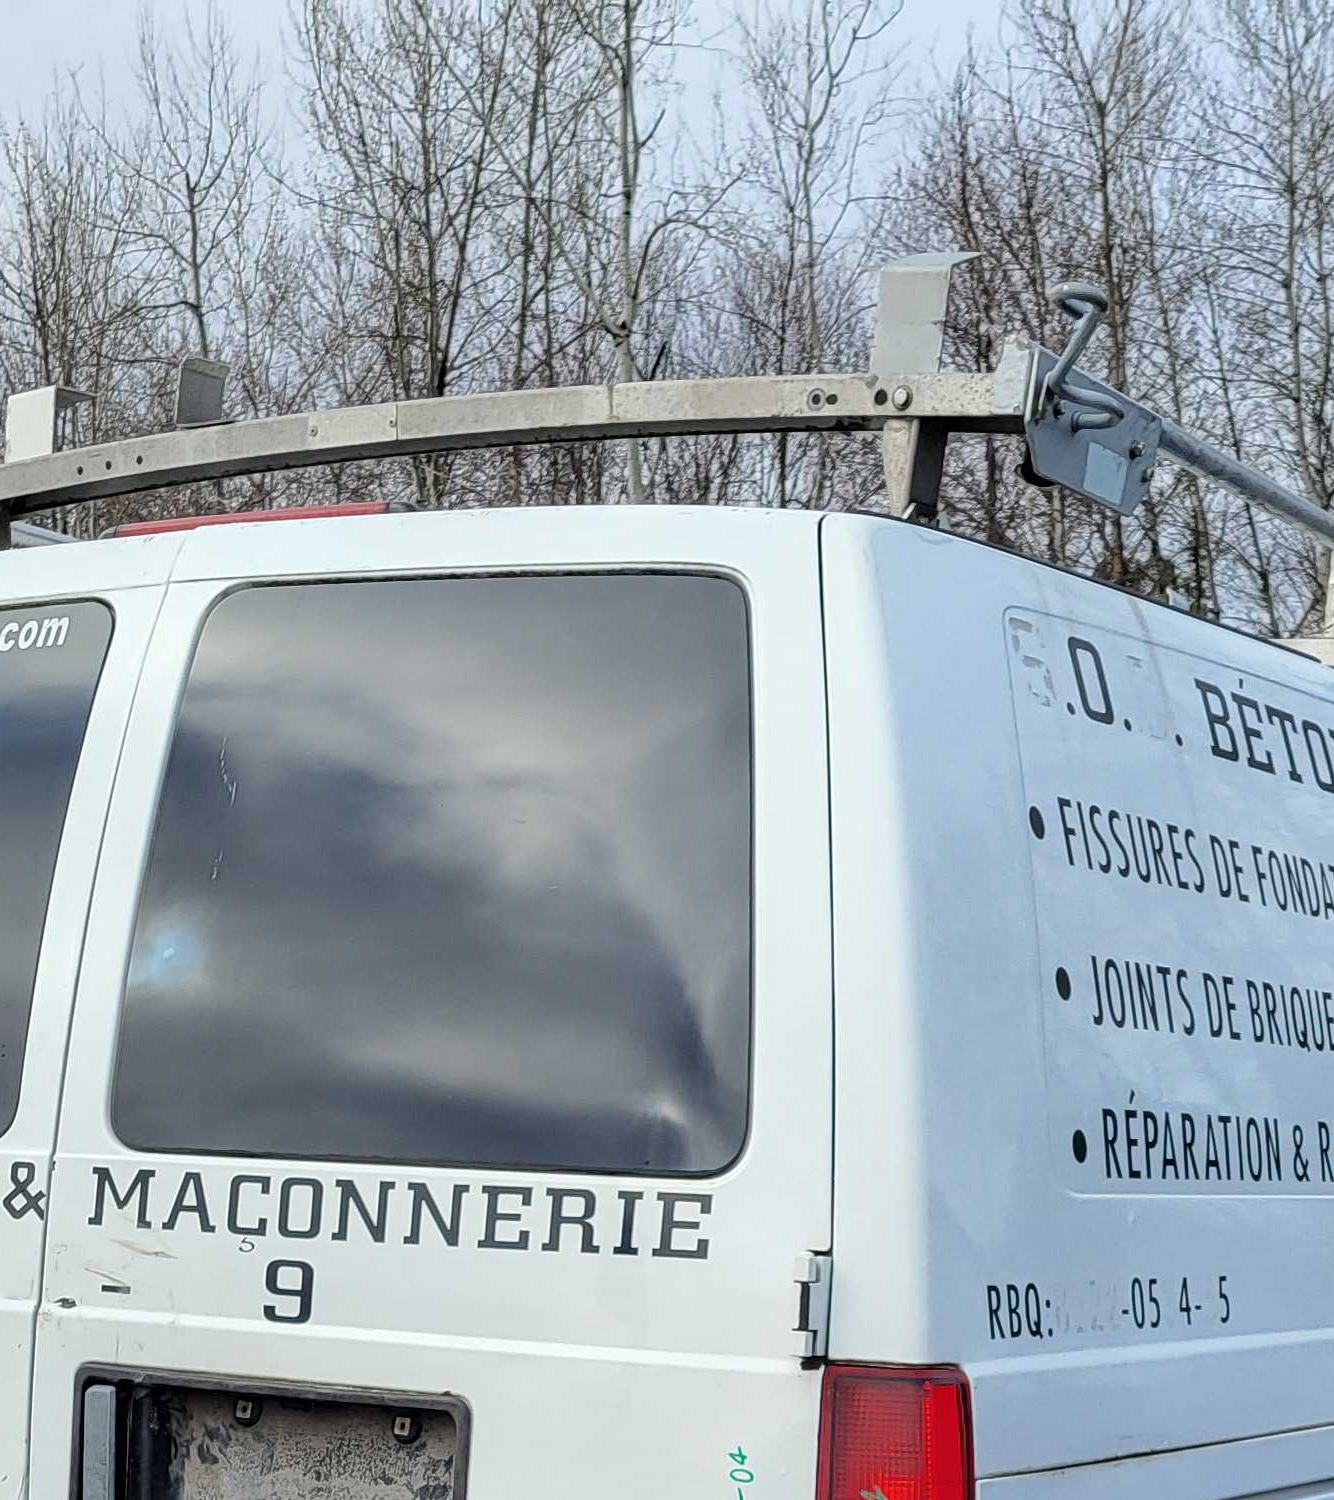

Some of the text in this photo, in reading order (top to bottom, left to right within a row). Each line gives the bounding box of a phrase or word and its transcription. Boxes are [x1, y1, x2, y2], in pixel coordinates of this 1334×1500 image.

[1058, 797, 1206, 894] FISSURES
[1209, 834, 1248, 901] DE
[1091, 955, 1196, 1036] JOINTS
[1203, 973, 1241, 1041] DE
[1102, 1091, 1281, 1182] RÉPARATION
[1293, 1125, 1311, 1181] &
[2, 1162, 47, 1220] &
[88, 1166, 714, 1261] MAÇONNERIE
[987, 1283, 1053, 1339] RBQ:
